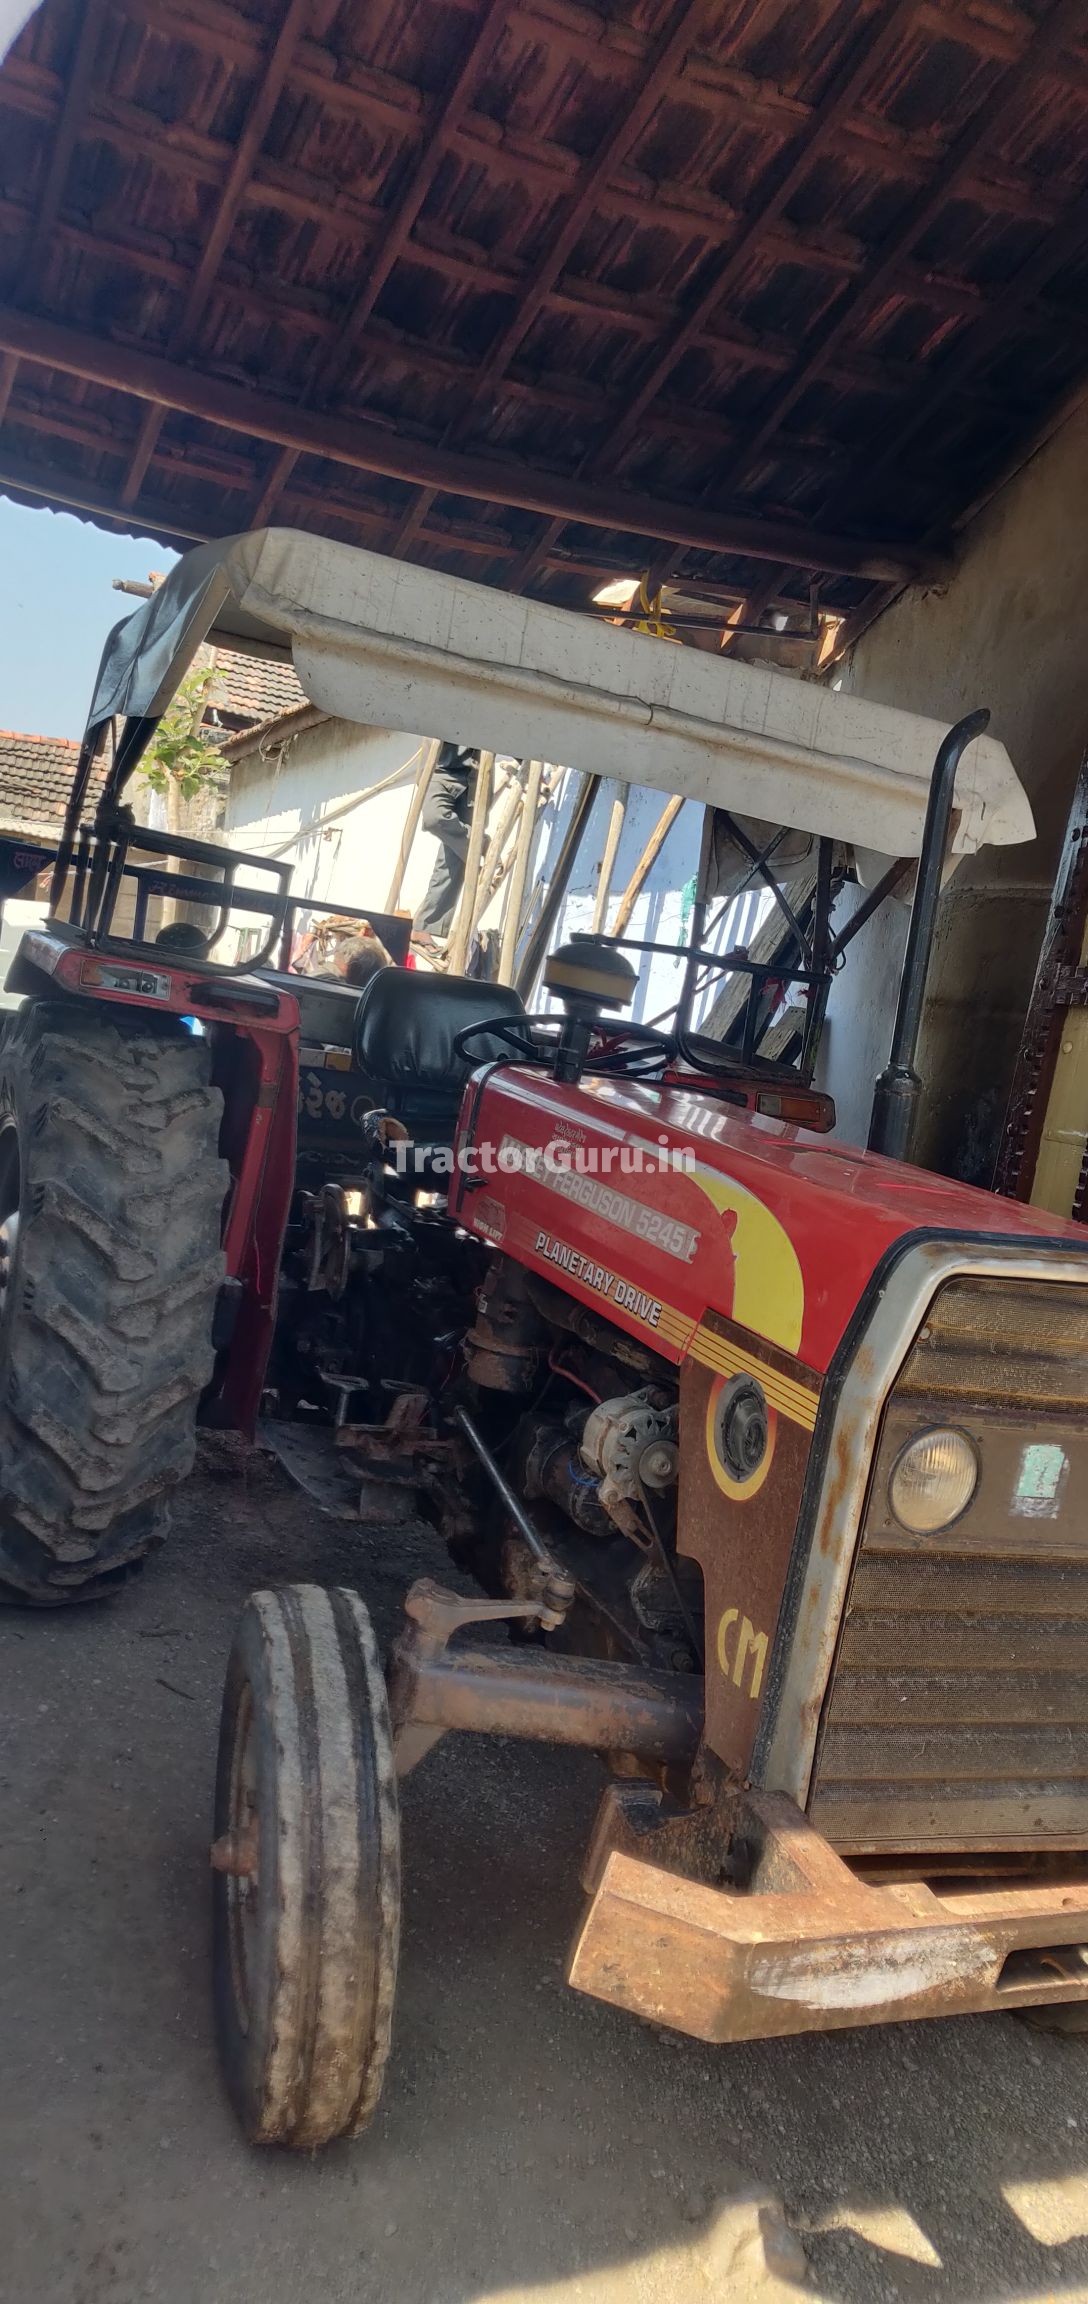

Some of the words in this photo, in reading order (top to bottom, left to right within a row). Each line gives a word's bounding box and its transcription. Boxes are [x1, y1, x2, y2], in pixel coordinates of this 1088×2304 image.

[553, 1168, 637, 1229] FERGUSON
[635, 1206, 686, 1253] 5245
[535, 1231, 615, 1296] PLANETARY
[613, 1280, 662, 1328] DRIVE
[717, 1608, 769, 1699] CM
